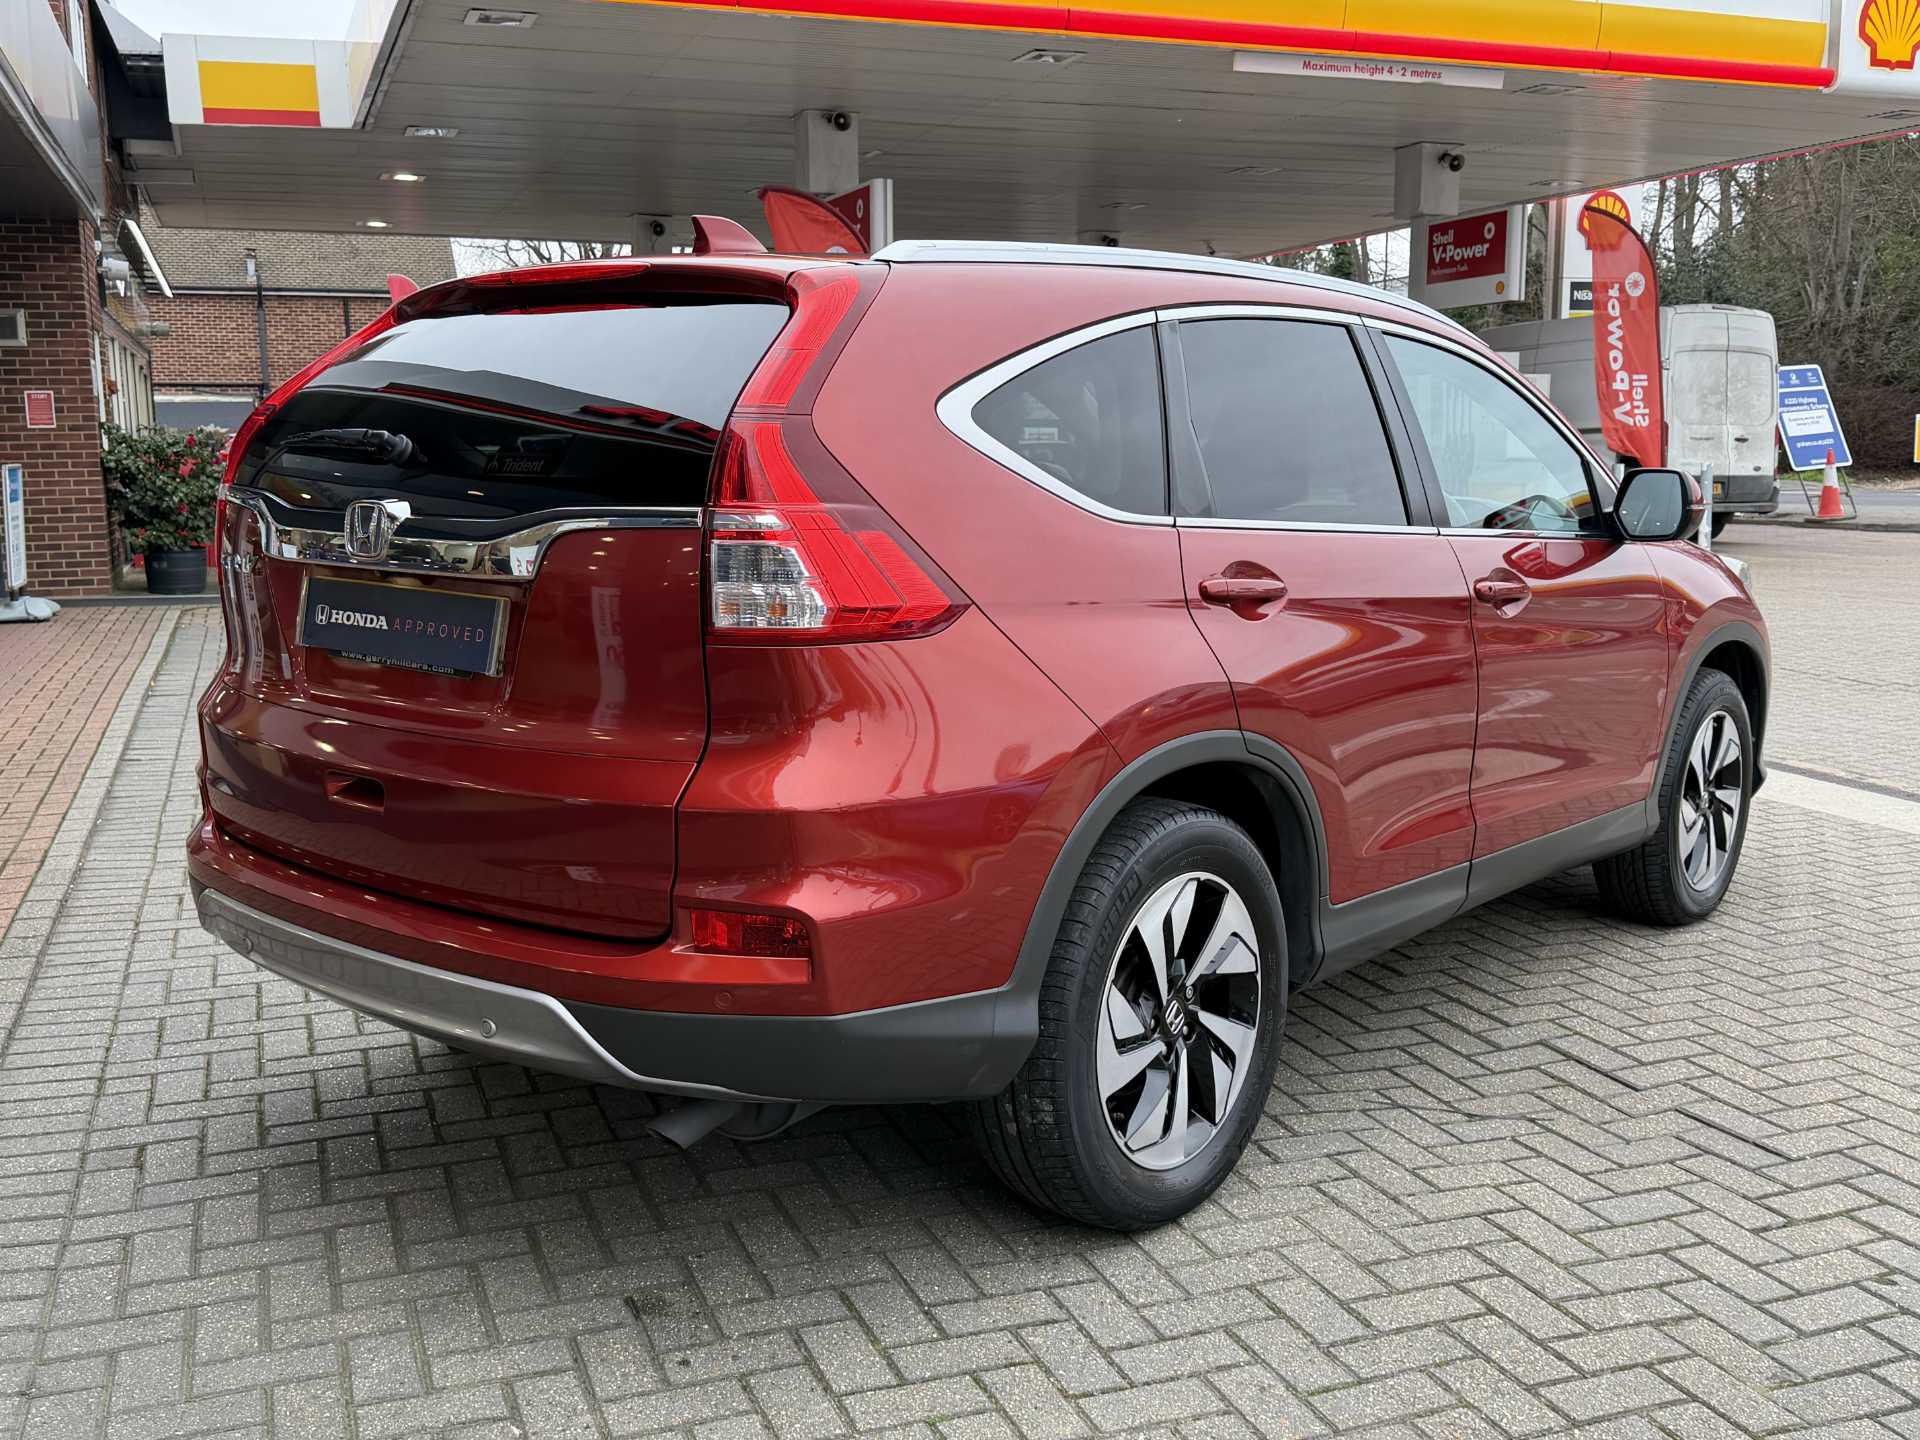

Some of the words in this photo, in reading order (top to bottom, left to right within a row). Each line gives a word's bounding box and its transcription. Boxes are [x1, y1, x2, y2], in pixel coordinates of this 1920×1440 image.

[1302, 59, 1351, 73] Maximum
[1354, 62, 1384, 77] height
[1410, 68, 1442, 80] metres
[1432, 229, 1454, 246] Shell
[1432, 242, 1490, 264] V-Power
[503, 458, 544, 472] Trident
[331, 609, 389, 630] HONDA
[392, 617, 485, 642] APPROVED
